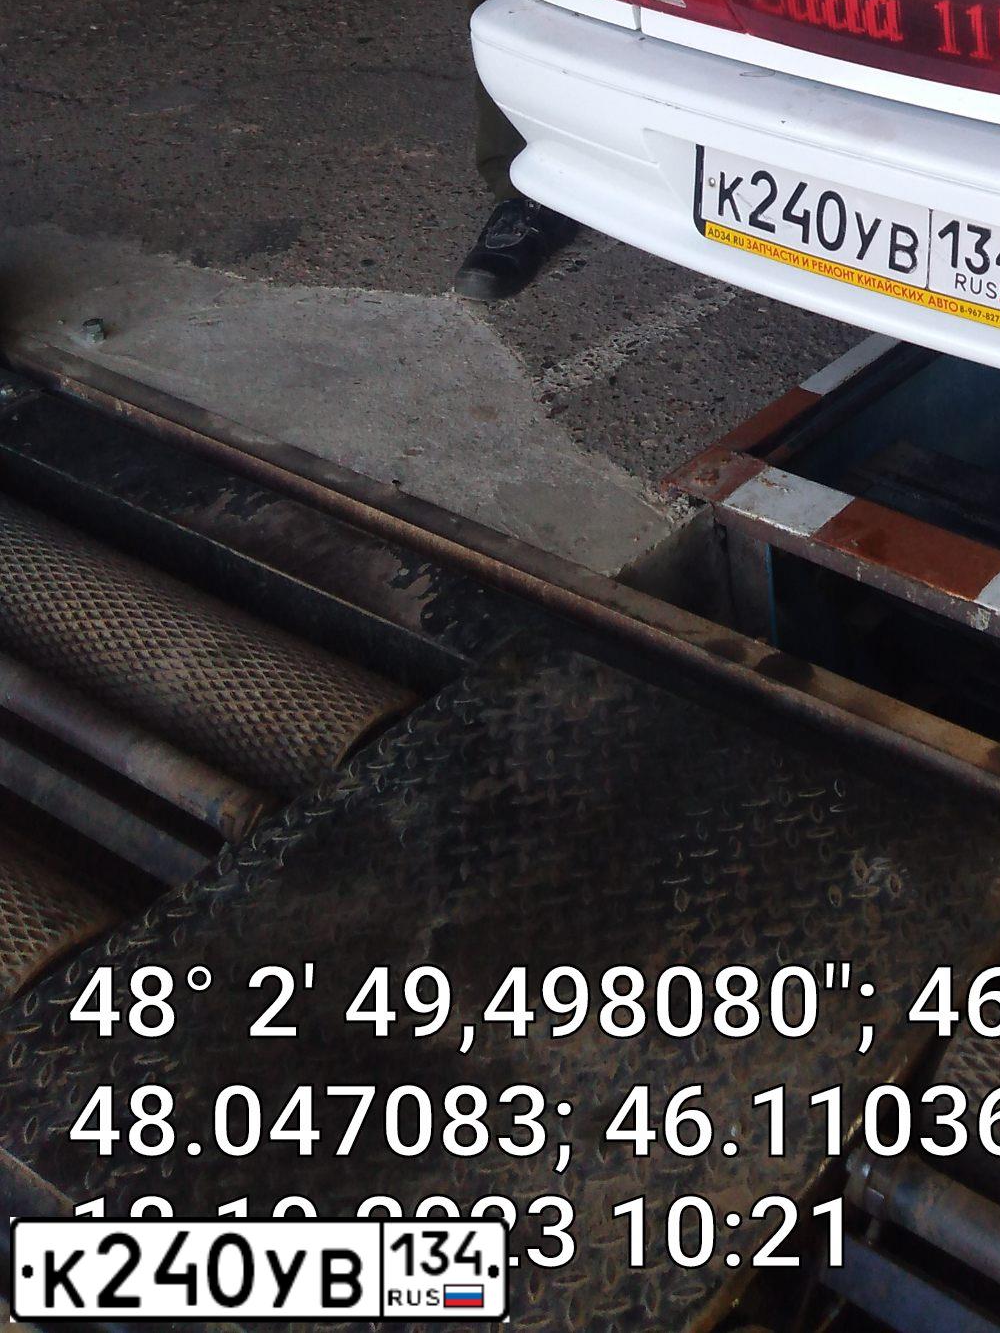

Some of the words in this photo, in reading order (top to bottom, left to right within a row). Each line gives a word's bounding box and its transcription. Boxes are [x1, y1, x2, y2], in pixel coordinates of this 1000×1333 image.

[746, 239, 800, 266] ЗАПЧАСТИ
[802, 254, 810, 268] И
[812, 257, 855, 281] РЕМОНТ
[857, 270, 924, 302] КИТАЙСКИХ
[927, 296, 959, 313] АВТО
[954, 272, 998, 300] RUS
